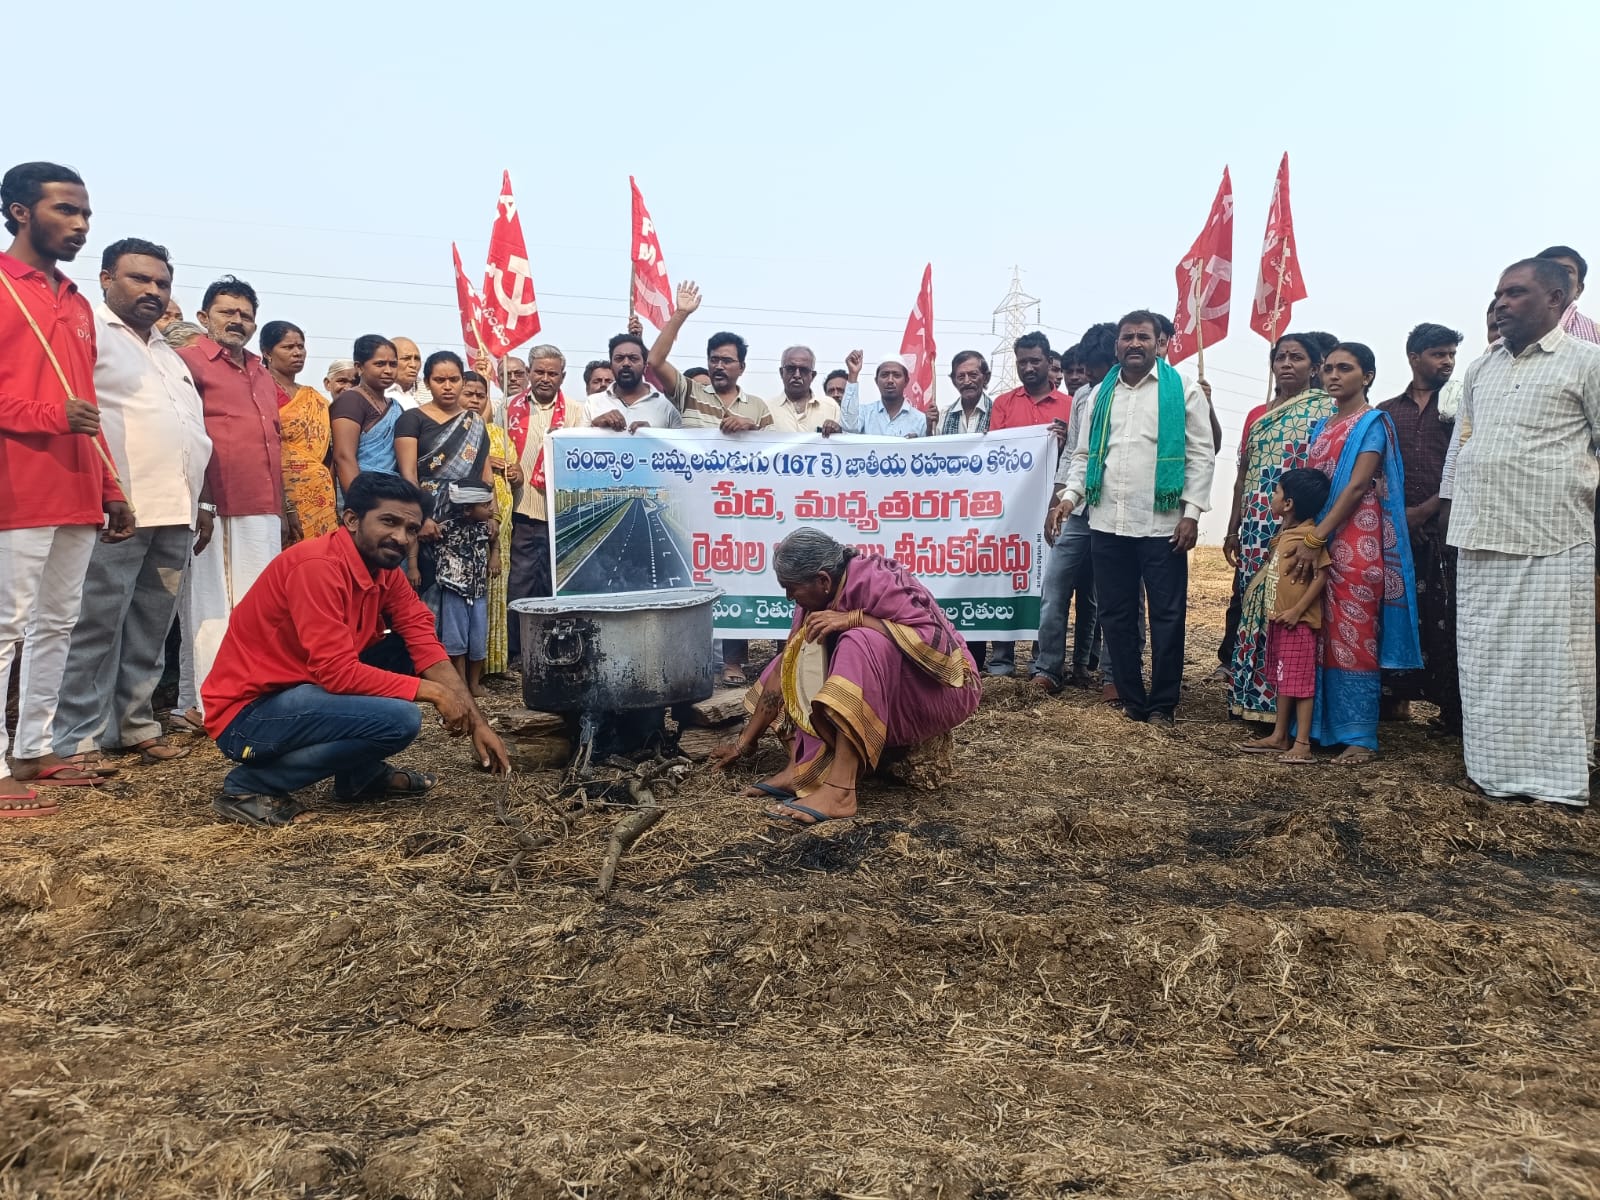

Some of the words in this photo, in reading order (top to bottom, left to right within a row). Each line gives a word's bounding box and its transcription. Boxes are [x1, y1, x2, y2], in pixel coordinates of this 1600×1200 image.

[567, 449, 635, 480] నంద్యాల
[651, 449, 769, 480] జమ్మలమడుగు
[773, 452, 817, 476] (167
[845, 450, 906, 477] జాతీయ
[910, 452, 983, 476] రహదారి
[986, 445, 1033, 473] కోసం
[711, 481, 783, 520] పేద,
[794, 489, 1003, 531] మధ్యతరగతి
[692, 533, 765, 581] రైతుల
[894, 529, 1032, 591] తీసుకోవద్దు
[961, 602, 1014, 626] రైతులు
